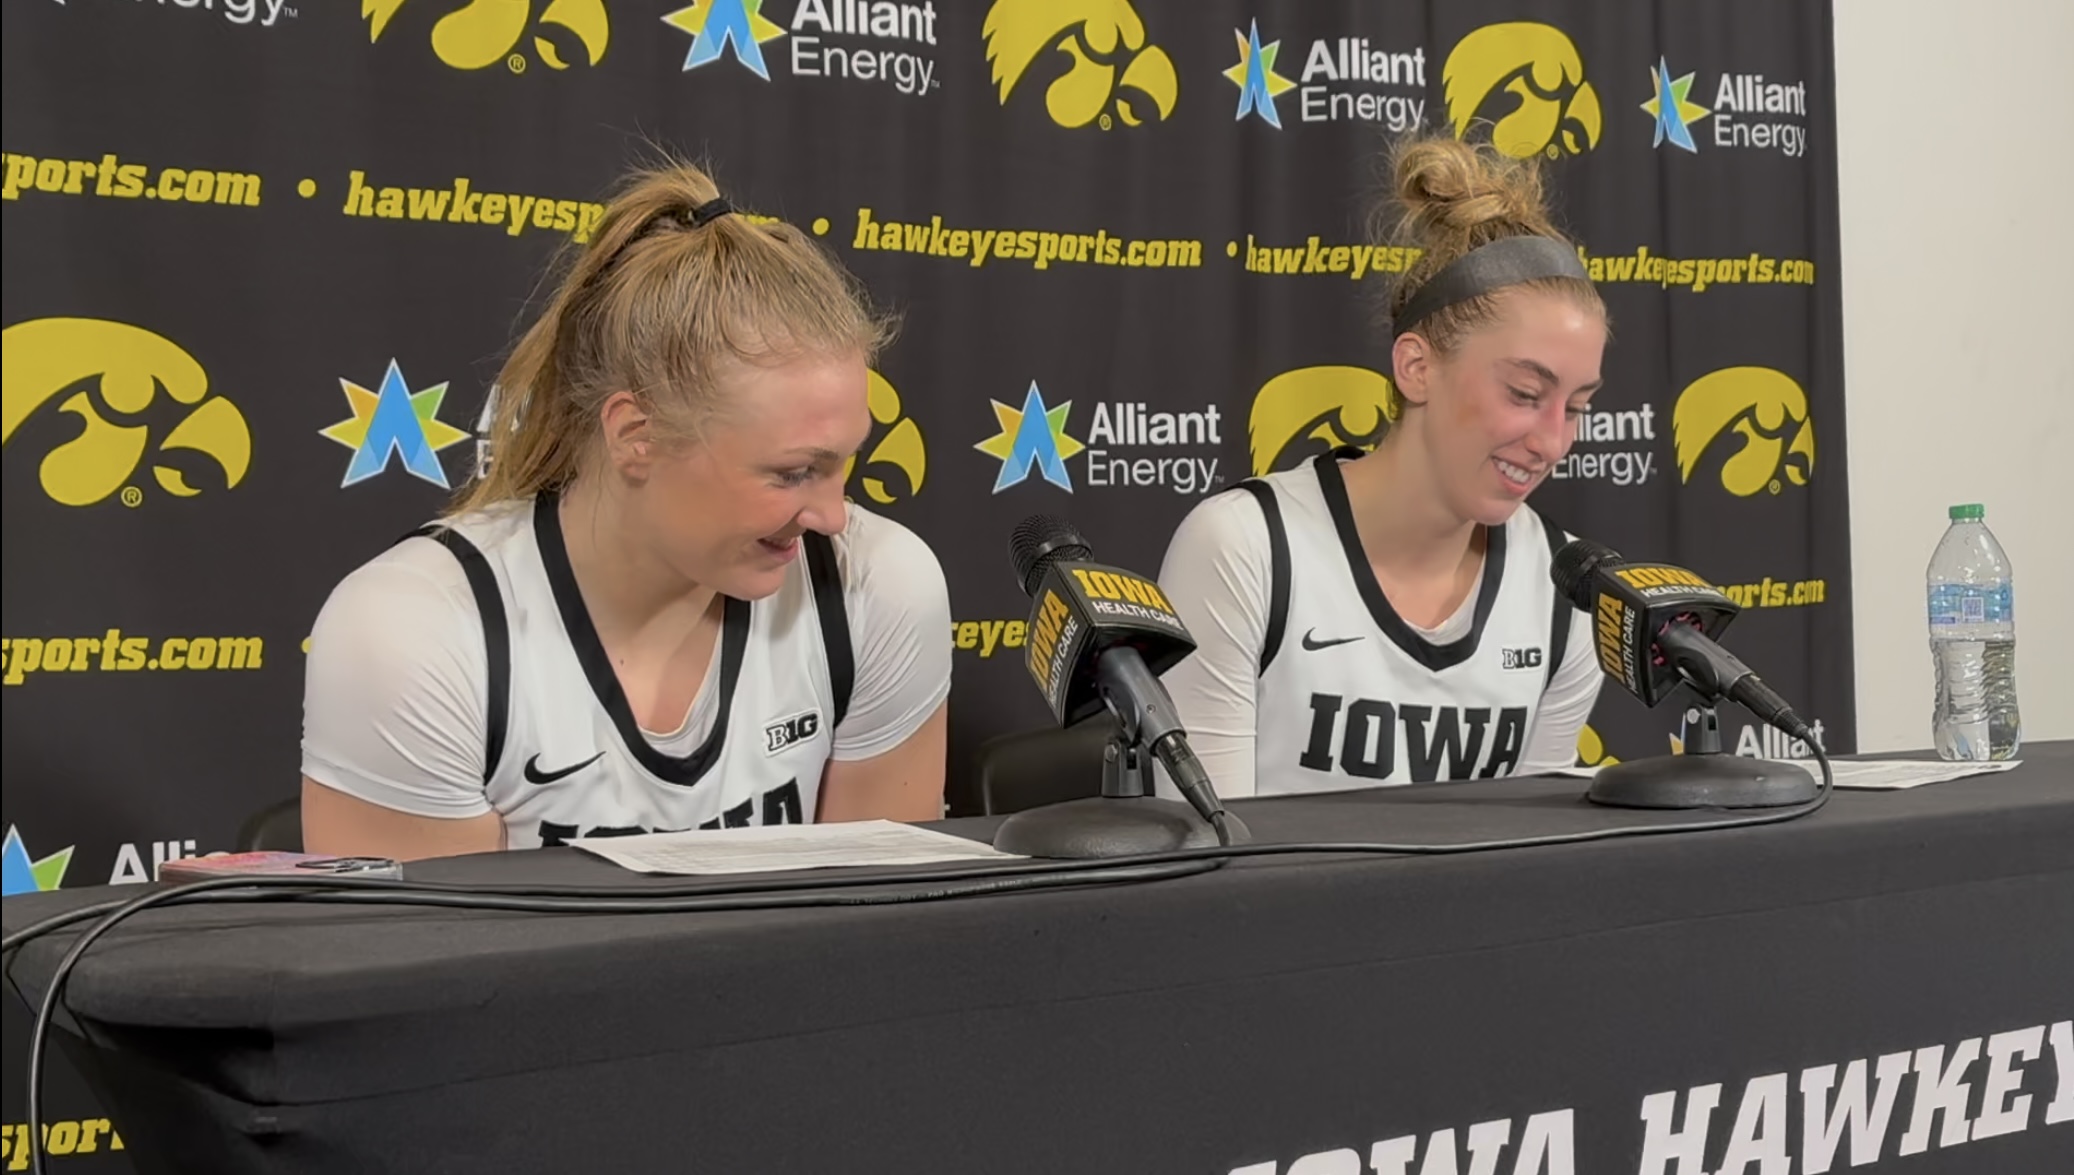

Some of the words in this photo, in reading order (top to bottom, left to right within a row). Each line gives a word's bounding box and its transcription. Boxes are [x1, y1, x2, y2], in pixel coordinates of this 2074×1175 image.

[790, 0, 937, 45] Alliant
[791, 36, 934, 96] Energy
[1300, 37, 1426, 86] Alliant
[1300, 86, 1425, 131] Energy
[1713, 72, 1806, 116] Alliant
[1713, 114, 1805, 157] Energy
[2, 153, 261, 206] ports.com
[853, 208, 1202, 270] hawkeyesports.com
[1087, 402, 1221, 445] Alliant
[1088, 450, 1218, 493] Energy
[1072, 569, 1174, 616] IOWA
[1615, 568, 1712, 589] IOWA
[1092, 601, 1151, 619] HEALTH
[1623, 605, 1636, 645] CARE
[1030, 588, 1069, 695] IOWA
[1058, 615, 1078, 659] CARE
[1598, 592, 1626, 685] IOWA
[1299, 692, 1528, 784] IOWA
